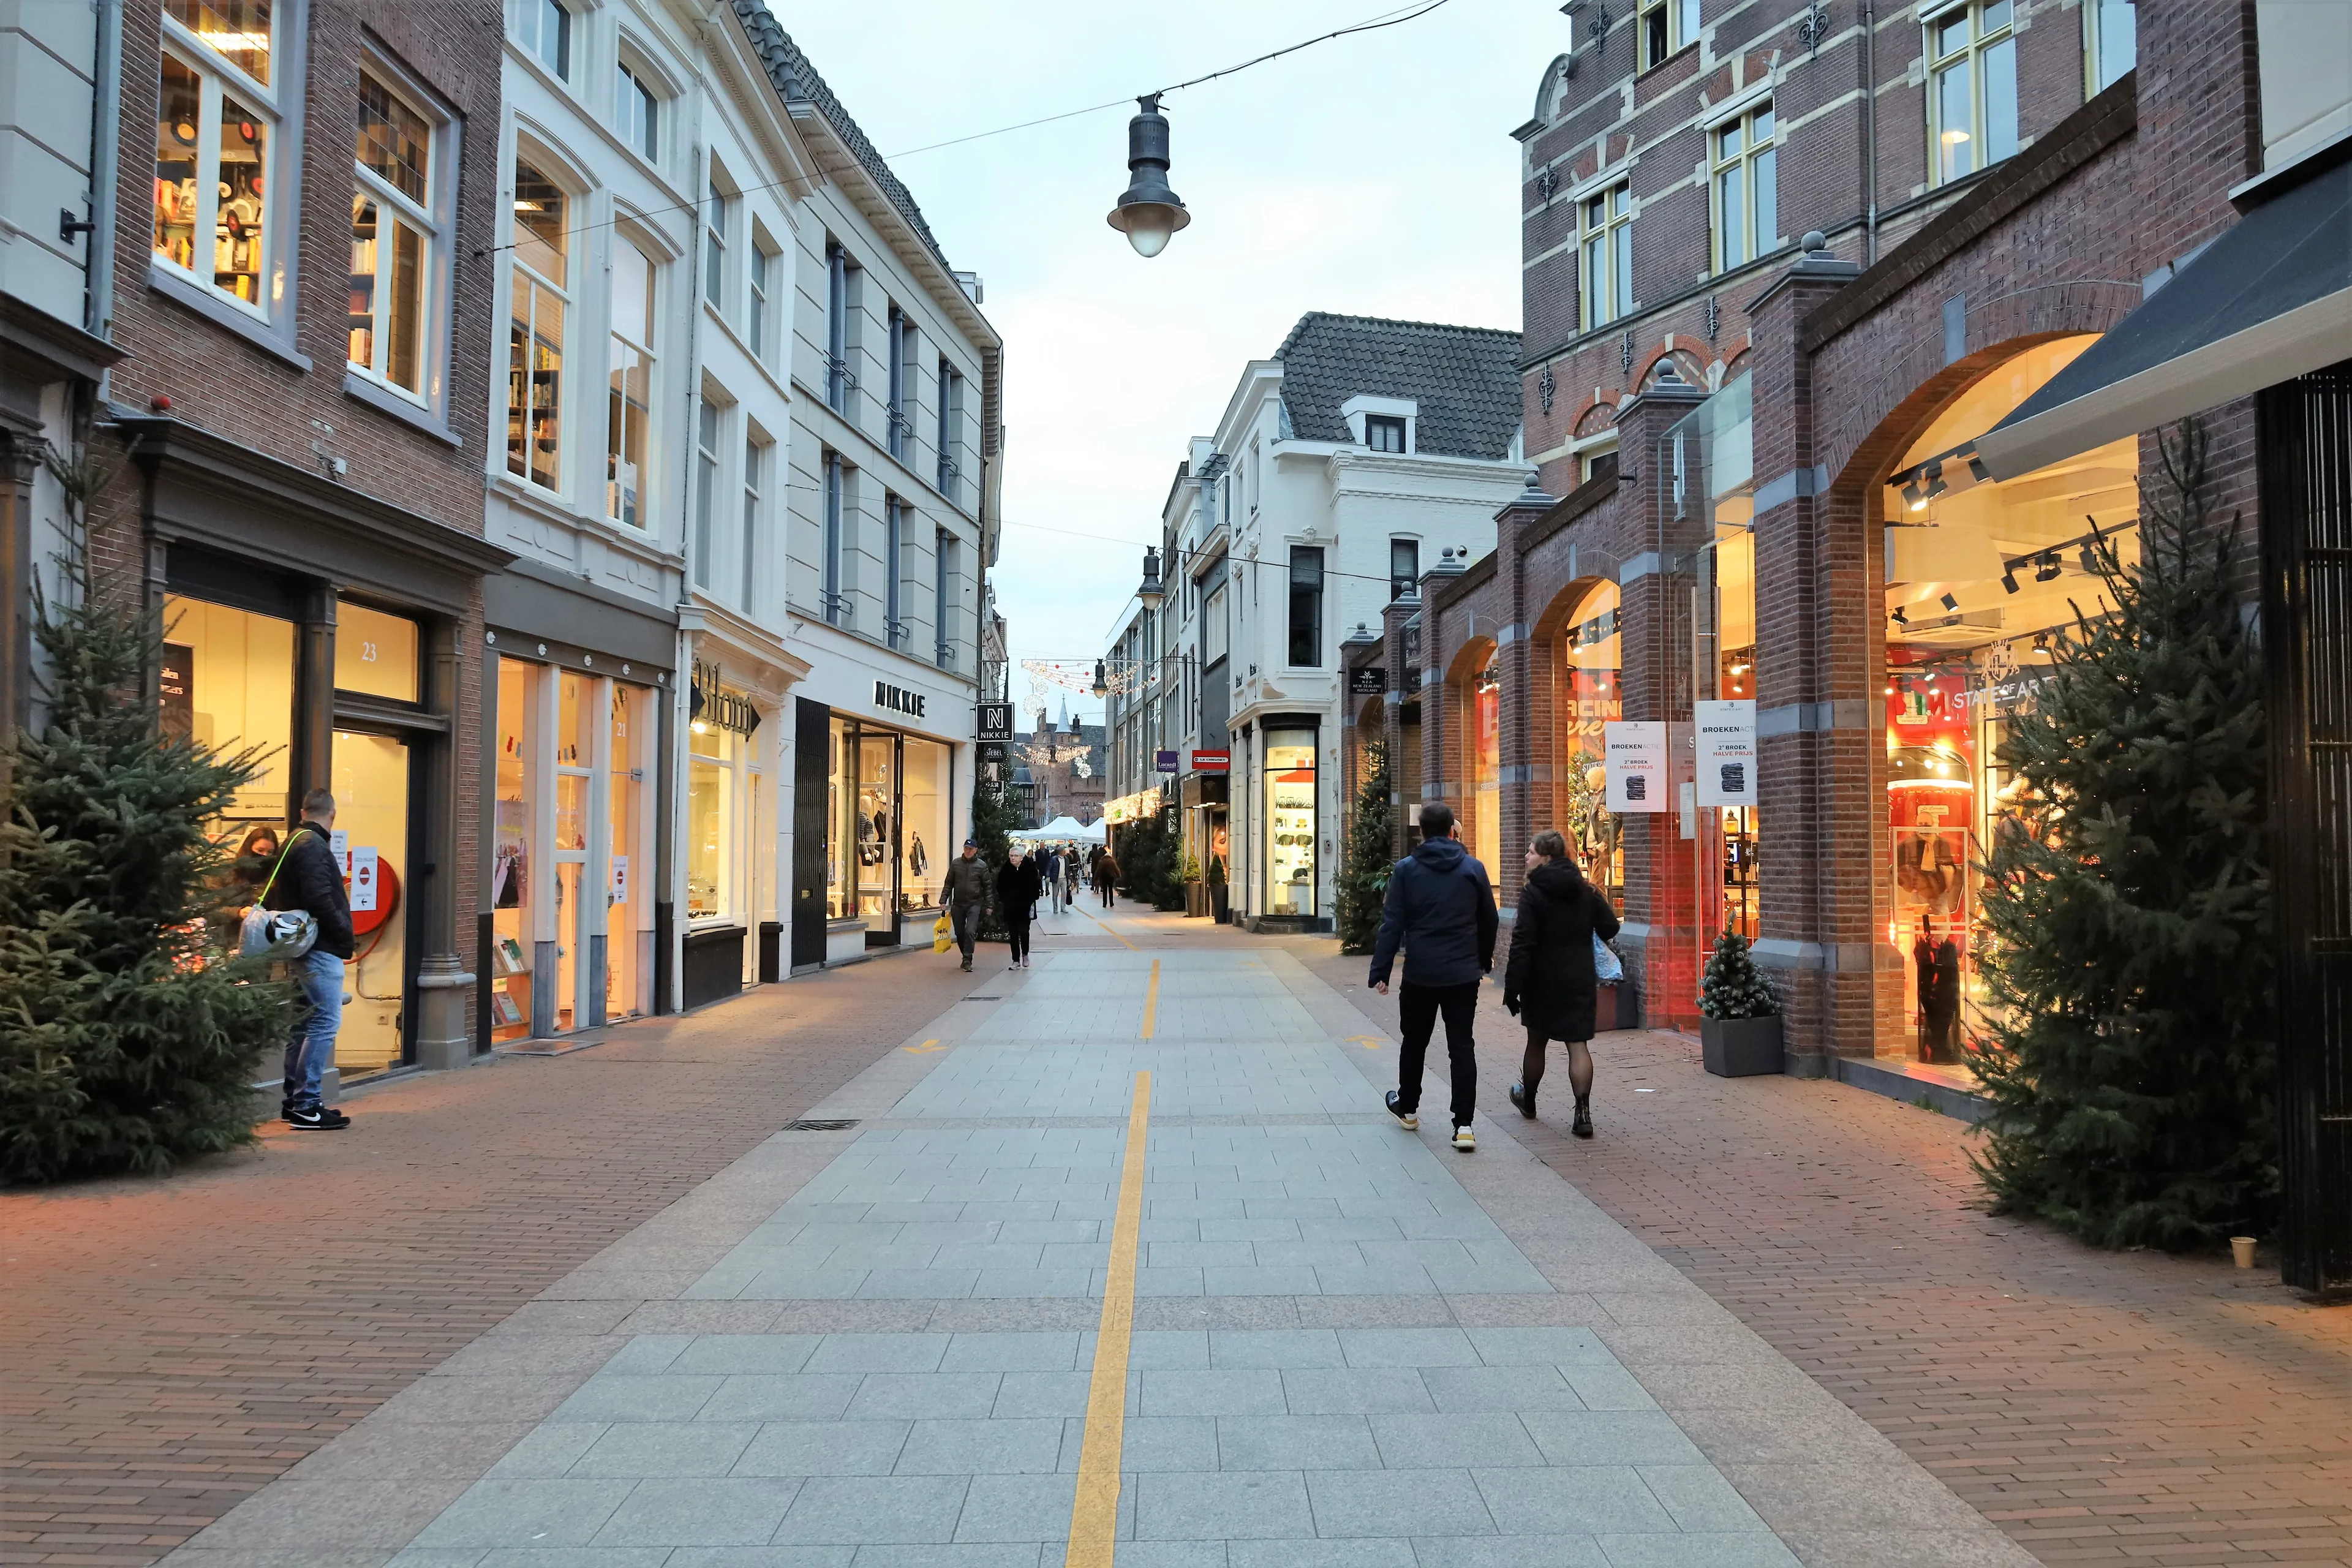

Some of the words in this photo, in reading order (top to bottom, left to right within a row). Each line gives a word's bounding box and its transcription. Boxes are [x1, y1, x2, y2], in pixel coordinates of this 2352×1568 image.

[362, 641, 377, 662] 23
[696, 657, 753, 736] Blom
[875, 680, 925, 718] NIKKIE
[1954, 685, 2001, 709] STATE
[987, 707, 1004, 729] N
[617, 722, 626, 737] 21
[986, 747, 1003, 756] SIEBEL
